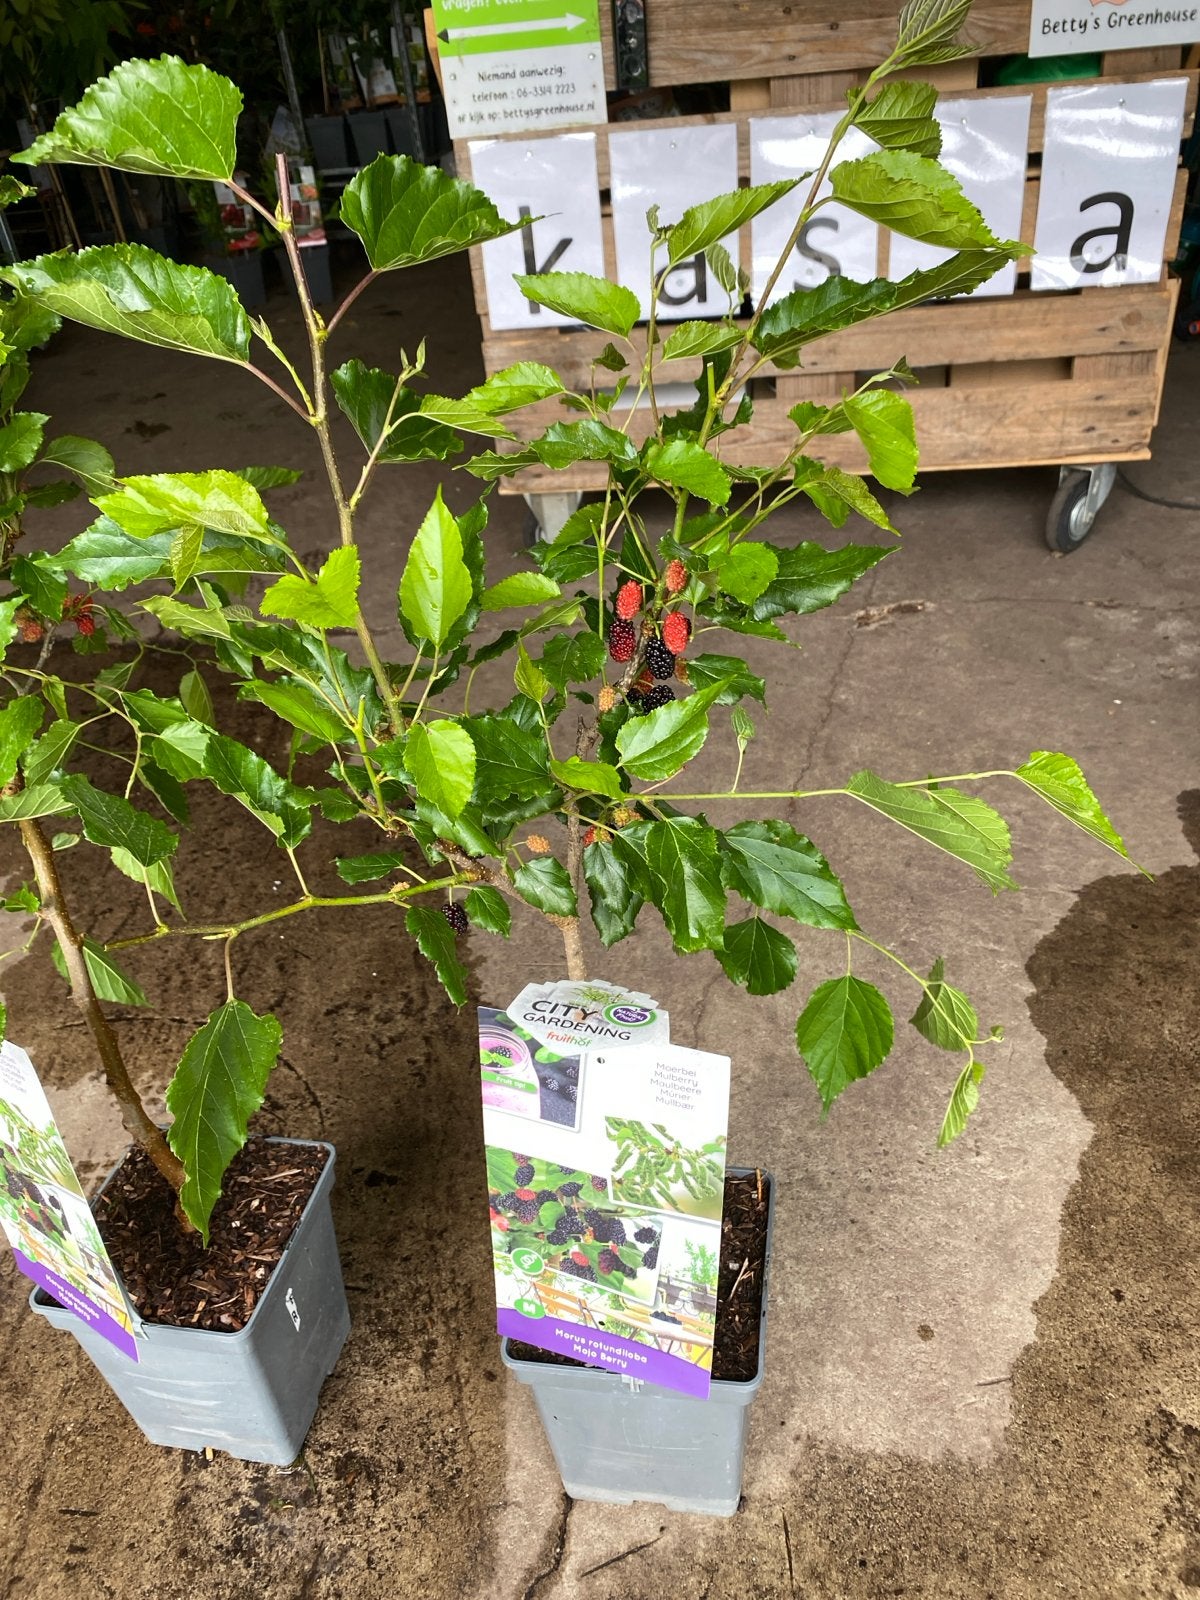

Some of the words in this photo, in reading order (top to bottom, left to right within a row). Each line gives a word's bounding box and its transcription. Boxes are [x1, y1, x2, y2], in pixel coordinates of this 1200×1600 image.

[1041, 11, 1100, 35] Betty's
[1108, 8, 1198, 28] Greenhouse
[477, 69, 516, 82] Niemand
[472, 90, 508, 102] telefoon
[556, 82, 576, 94] 2223
[469, 112, 484, 124] kijk
[503, 101, 595, 118] bettysgreenhouse.nl
[531, 1000, 598, 1021] CITY
[523, 1012, 632, 1041] GARDENING
[654, 1070, 698, 1087] Mulberry
[656, 1062, 697, 1077] Moerbei
[650, 1078, 702, 1095] Maulbeere
[555, 1328, 586, 1344] Morus
[588, 1340, 648, 1364] rotundiloba
[573, 1344, 598, 1357] Mojo
[600, 1352, 627, 1368] Berry
